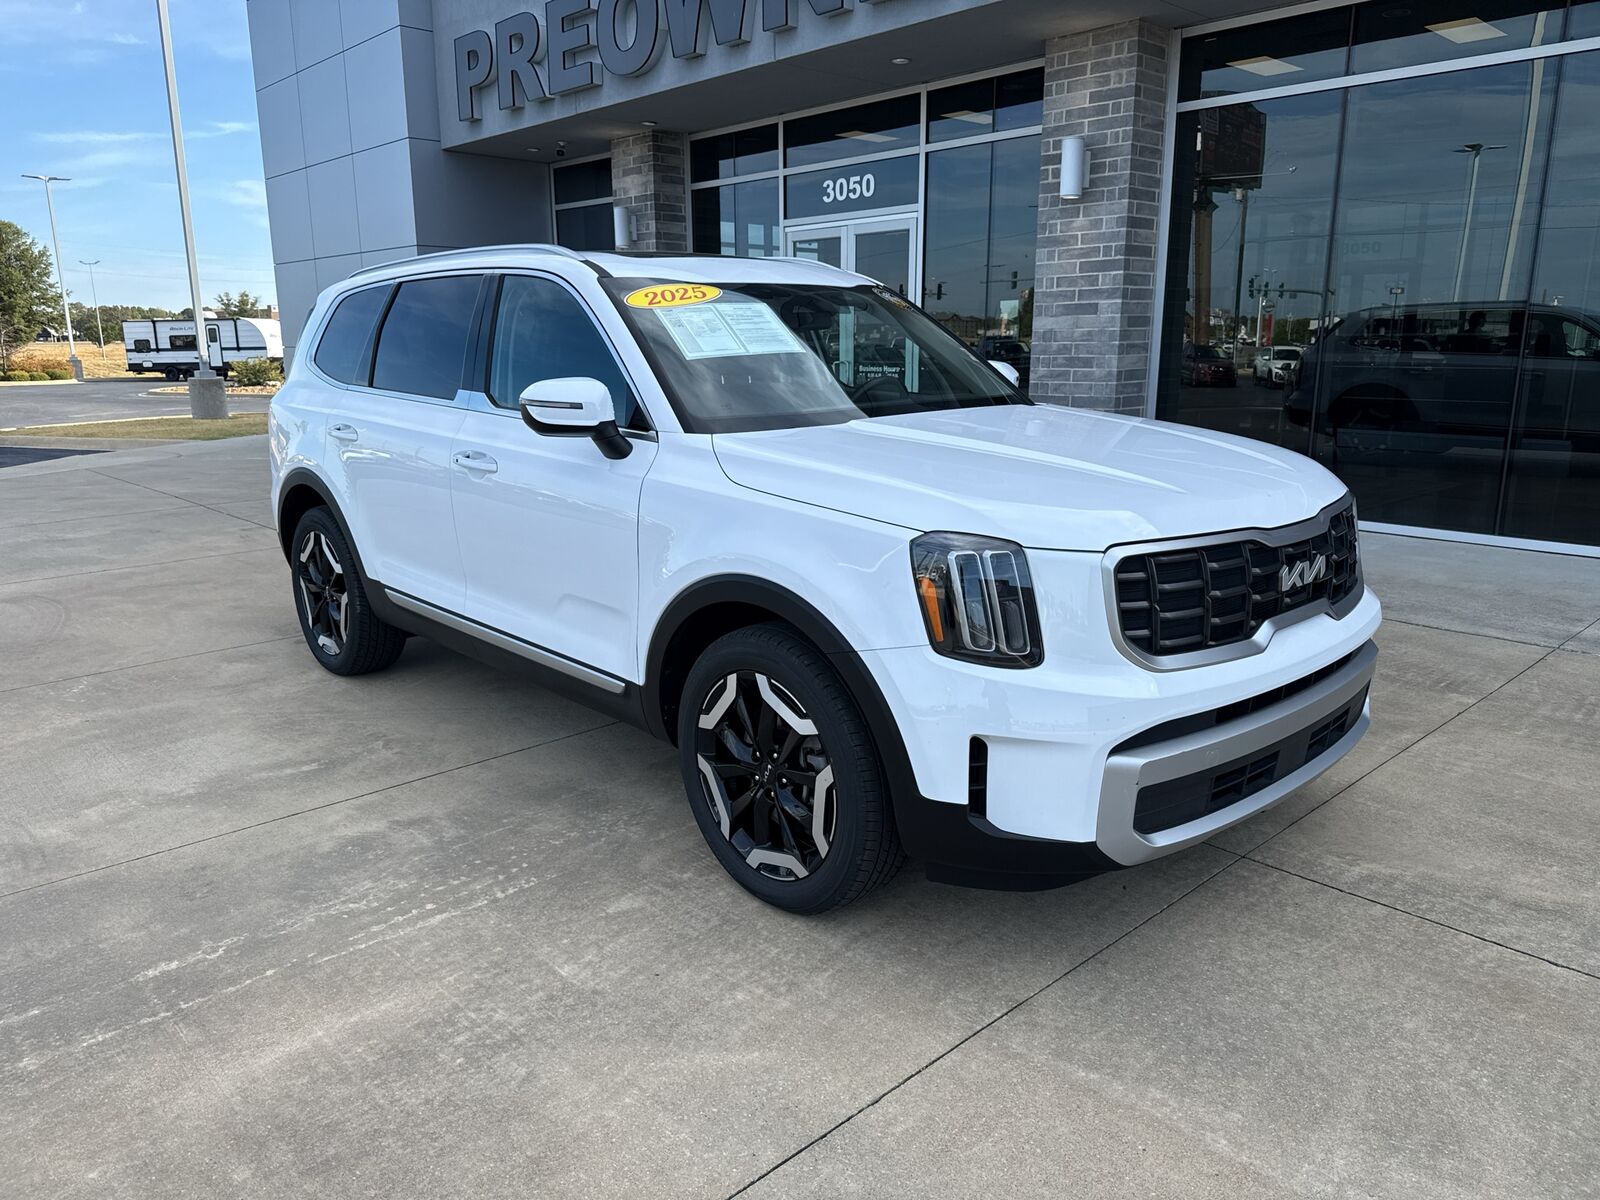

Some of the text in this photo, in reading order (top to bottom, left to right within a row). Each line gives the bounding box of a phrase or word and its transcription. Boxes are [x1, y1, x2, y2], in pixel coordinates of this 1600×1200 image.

[454, 0, 886, 121] PREOW
[822, 173, 875, 203] 3050
[644, 286, 707, 305] 2025
[1279, 553, 1326, 592] KIA
